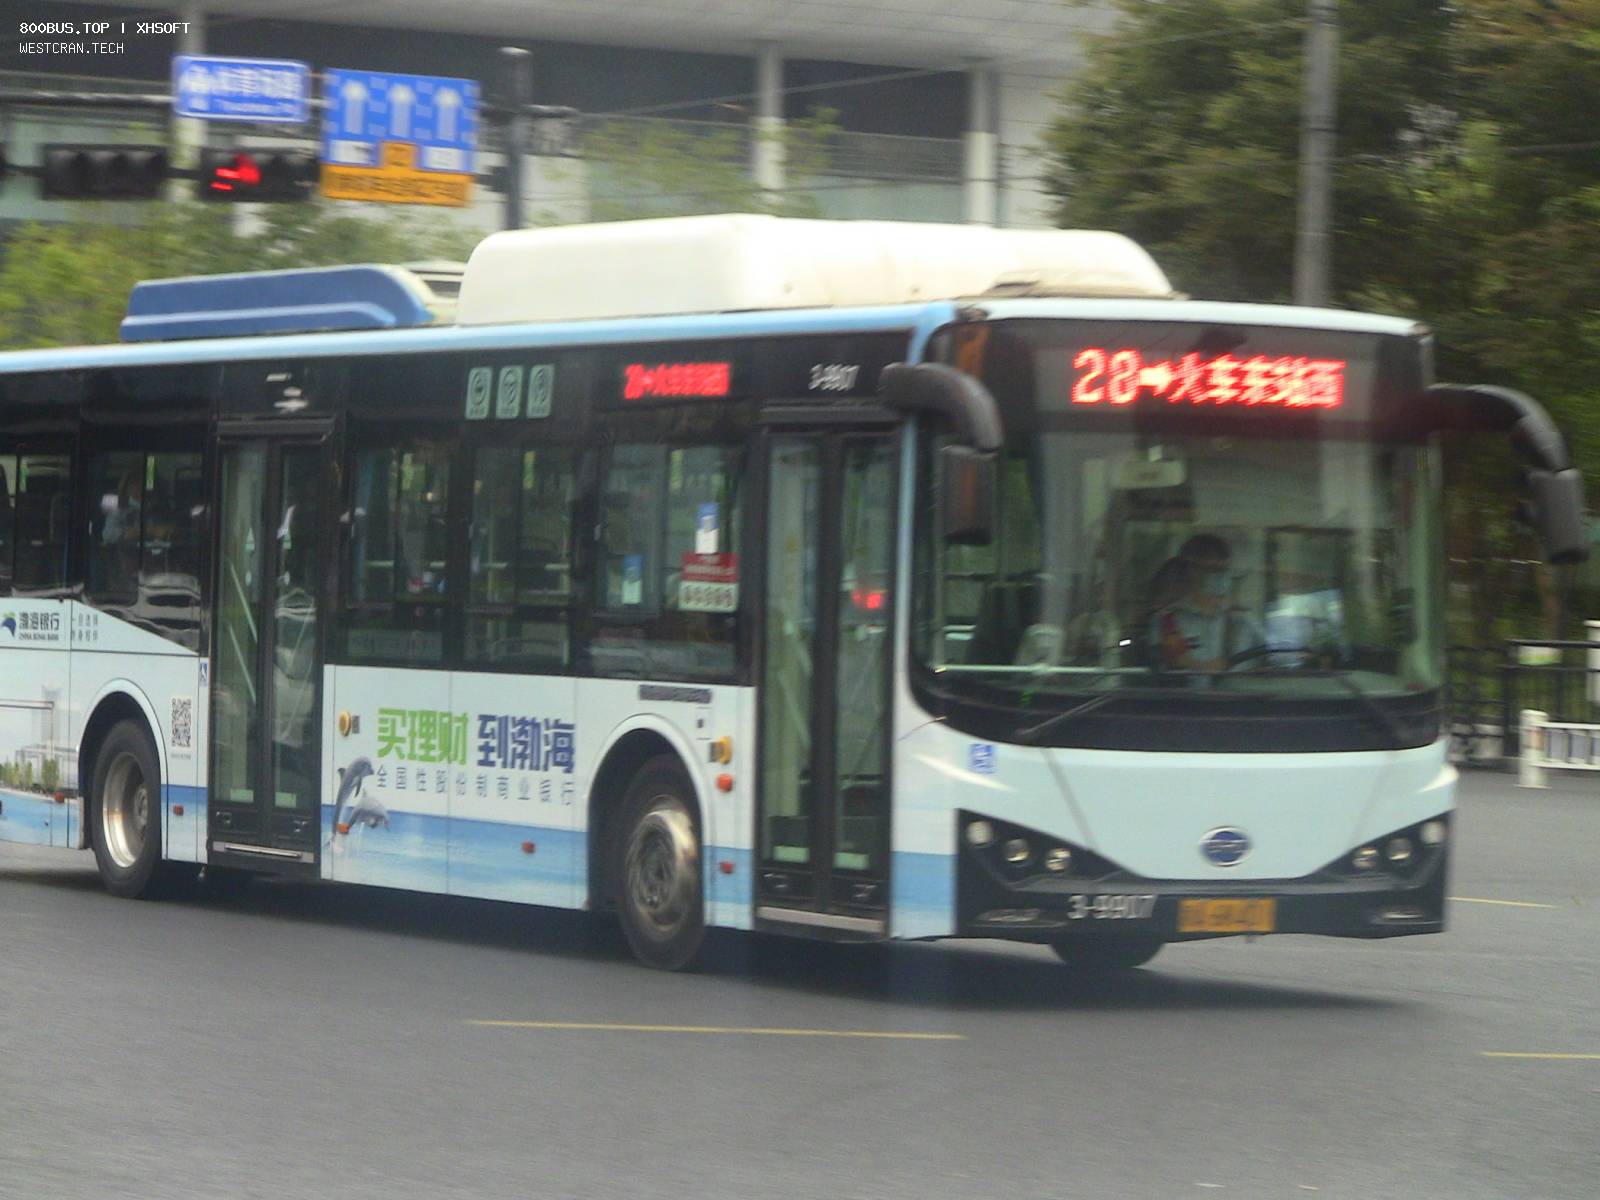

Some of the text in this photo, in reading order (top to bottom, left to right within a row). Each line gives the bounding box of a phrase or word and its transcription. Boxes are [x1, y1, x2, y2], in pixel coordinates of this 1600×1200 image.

[377, 707, 576, 774] 买理财 到渤海
